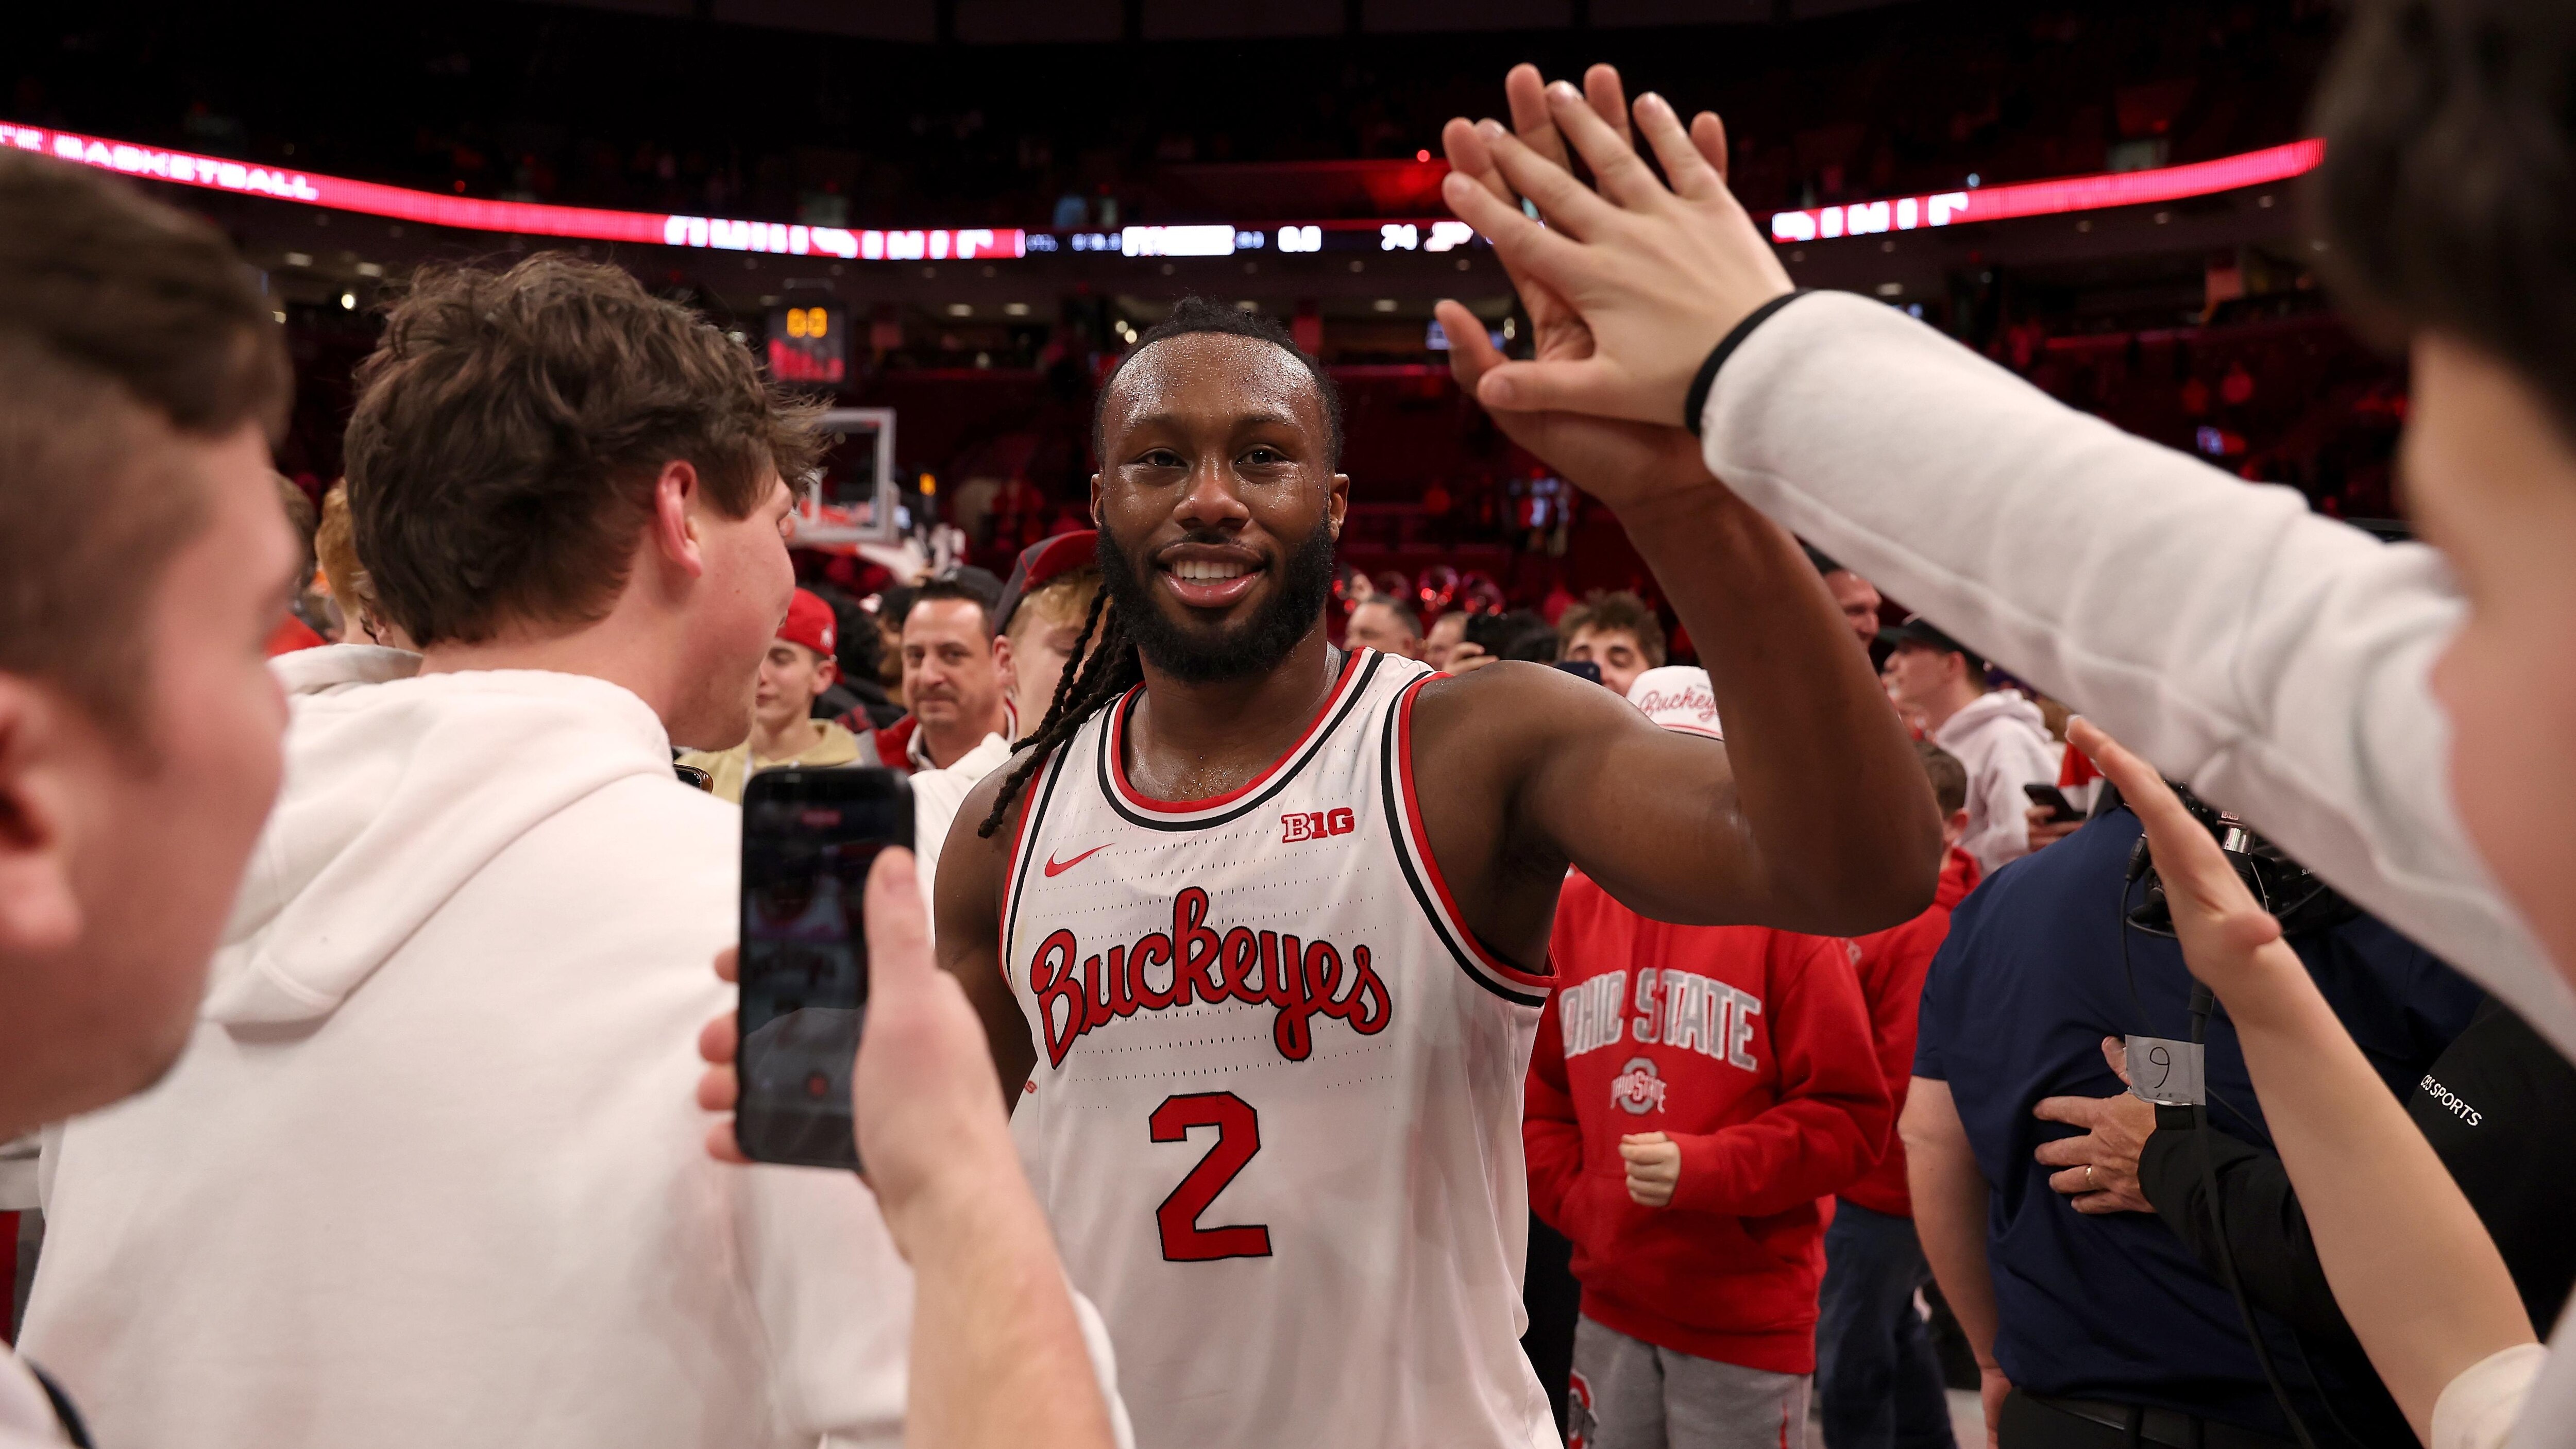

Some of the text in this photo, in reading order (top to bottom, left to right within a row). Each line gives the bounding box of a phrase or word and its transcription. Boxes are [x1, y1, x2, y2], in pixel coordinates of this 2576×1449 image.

[1638, 685, 1716, 721] Buckey
[1030, 886, 1392, 1070] Buckeyes
[1558, 967, 1762, 1073] OHIO STATE
[2149, 1047, 2170, 1089] 9
[2429, 1083, 2482, 1126] SPORTS
[1149, 1091, 1272, 1261] 2
